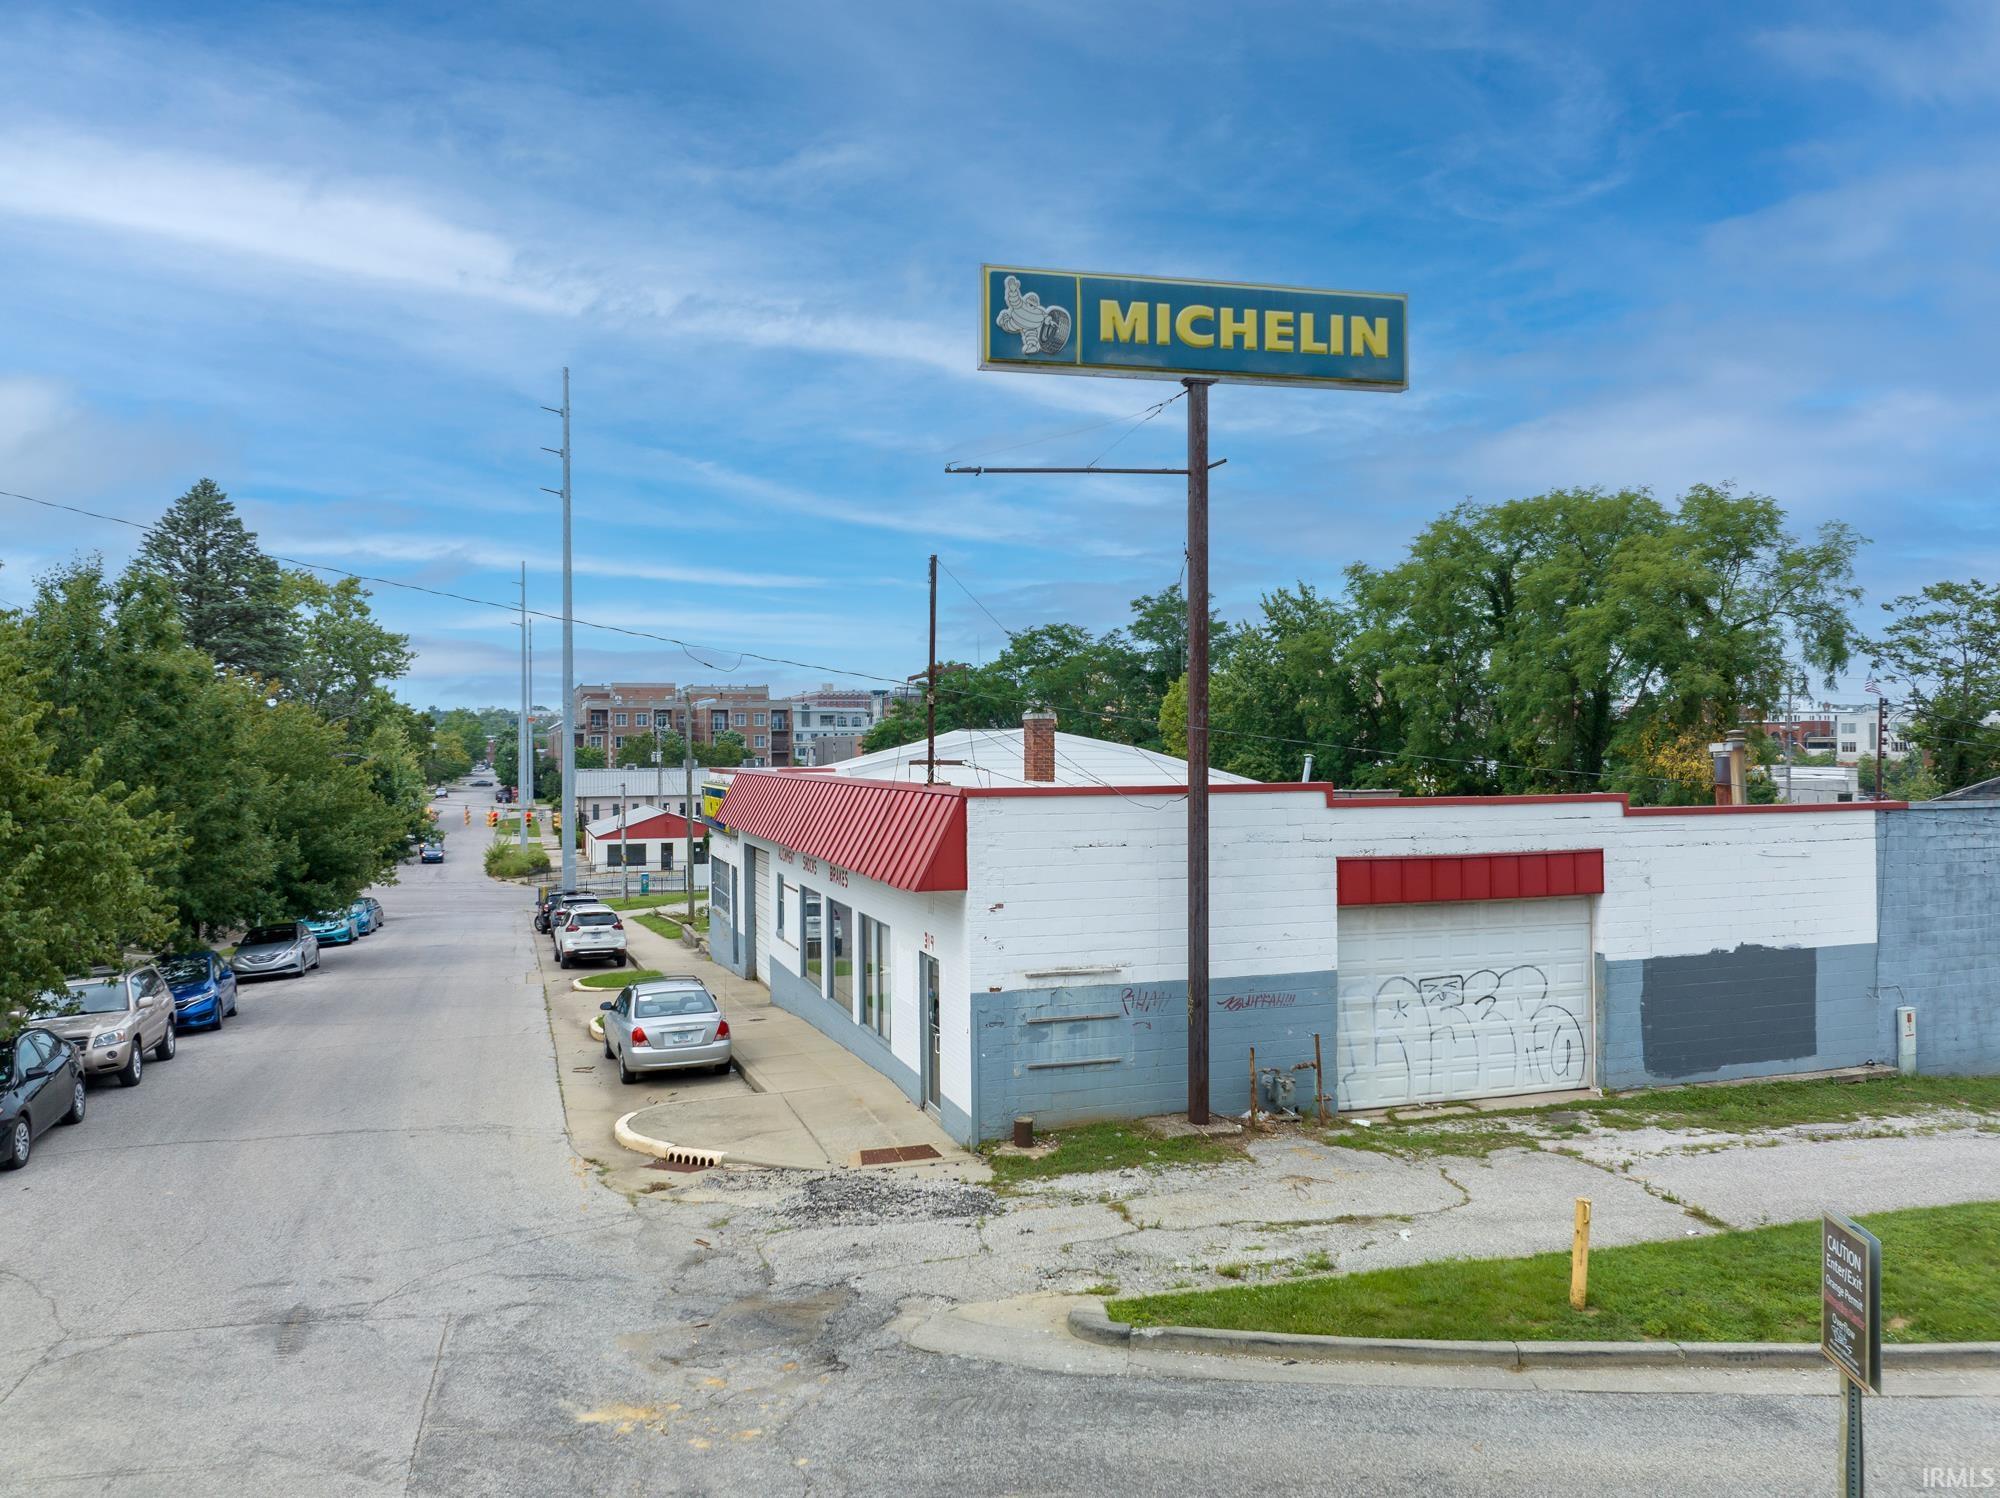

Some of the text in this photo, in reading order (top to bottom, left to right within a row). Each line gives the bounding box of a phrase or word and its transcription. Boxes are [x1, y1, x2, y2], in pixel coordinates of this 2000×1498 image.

[1099, 298, 1390, 359] MICHELIN
[802, 855, 817, 875] SHOCKS
[829, 865, 849, 888] BRAKES
[924, 931, 935, 952] 319
[1827, 1235, 1862, 1272] CAUTION
[1826, 1253, 1863, 1292] Enter/Exit
[1825, 1273, 1845, 1297] Orange
[1844, 1288, 1863, 1312] Permit
[1831, 1312, 1856, 1340] Overflow
